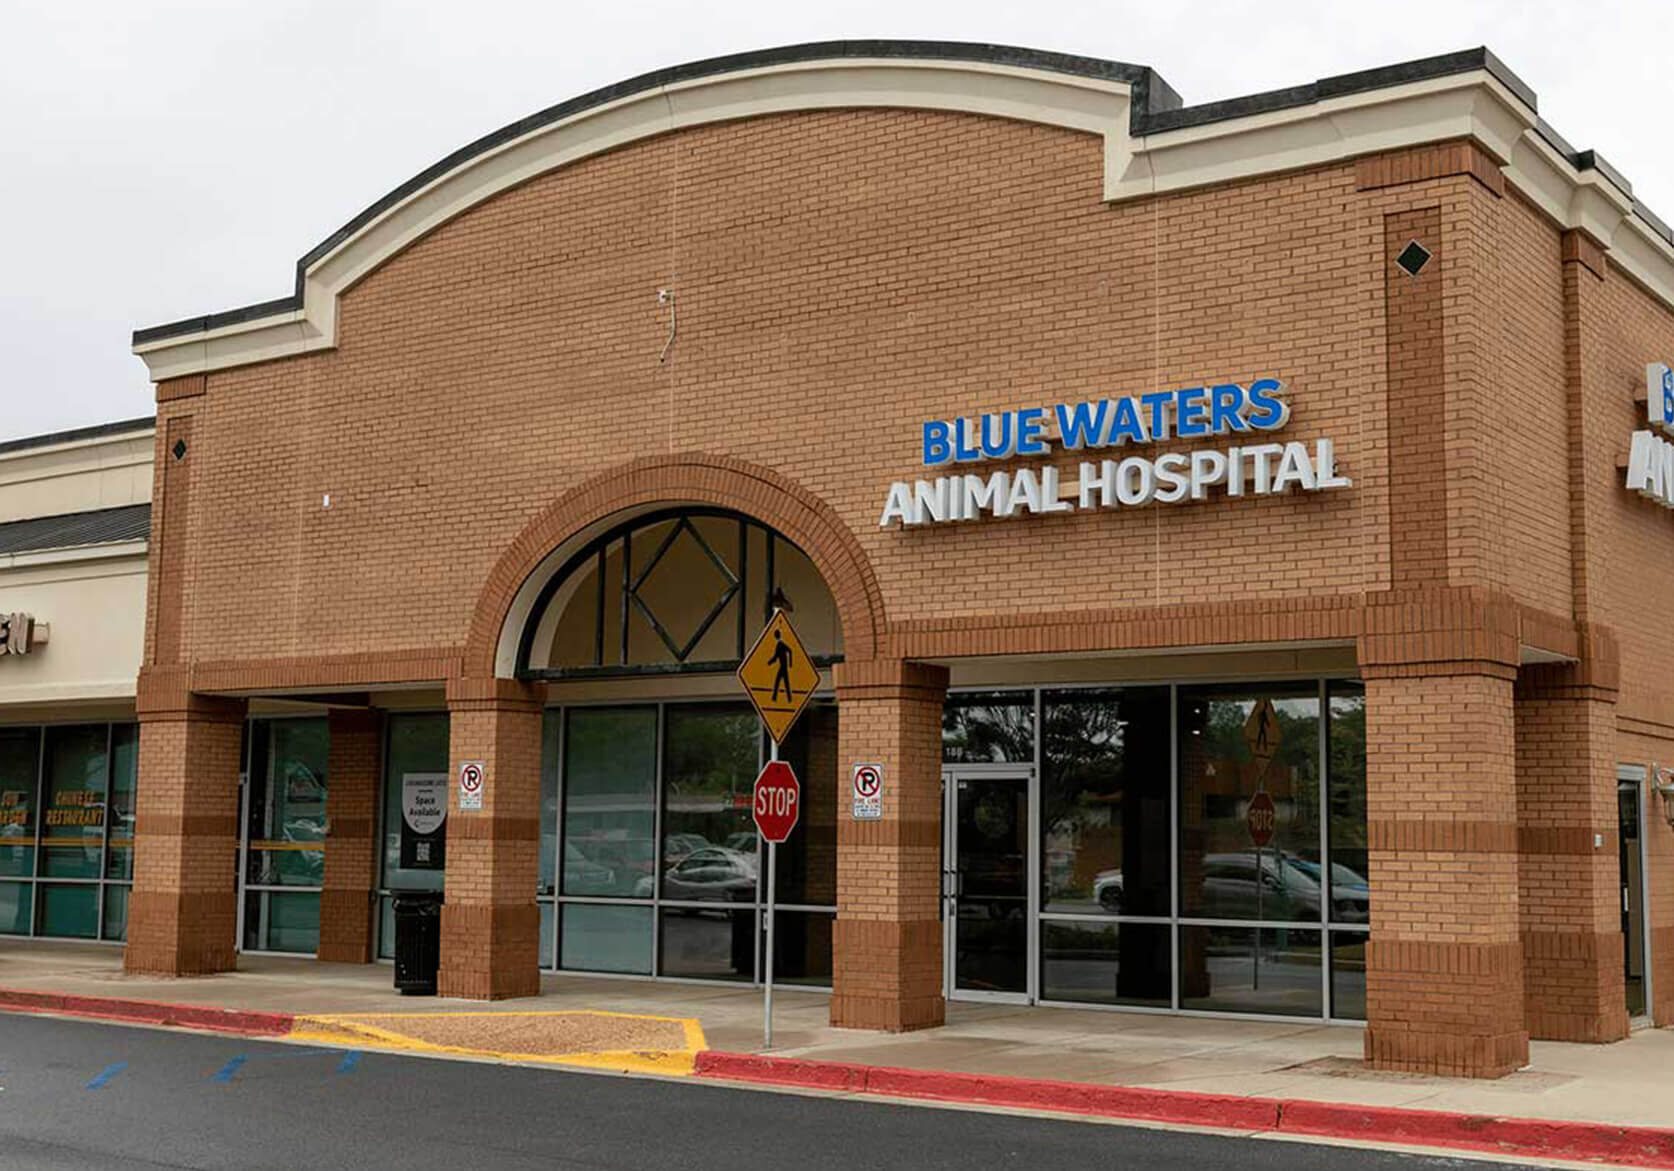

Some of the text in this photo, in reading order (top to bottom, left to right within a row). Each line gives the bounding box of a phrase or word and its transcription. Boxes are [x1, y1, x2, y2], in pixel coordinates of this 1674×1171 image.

[923, 378, 1290, 465] BLUE WATERS
[879, 438, 1353, 528] ANIMAL HOSPITAL
[409, 806, 441, 816] Available
[415, 795, 436, 806] Space
[756, 786, 796, 816] STOP
